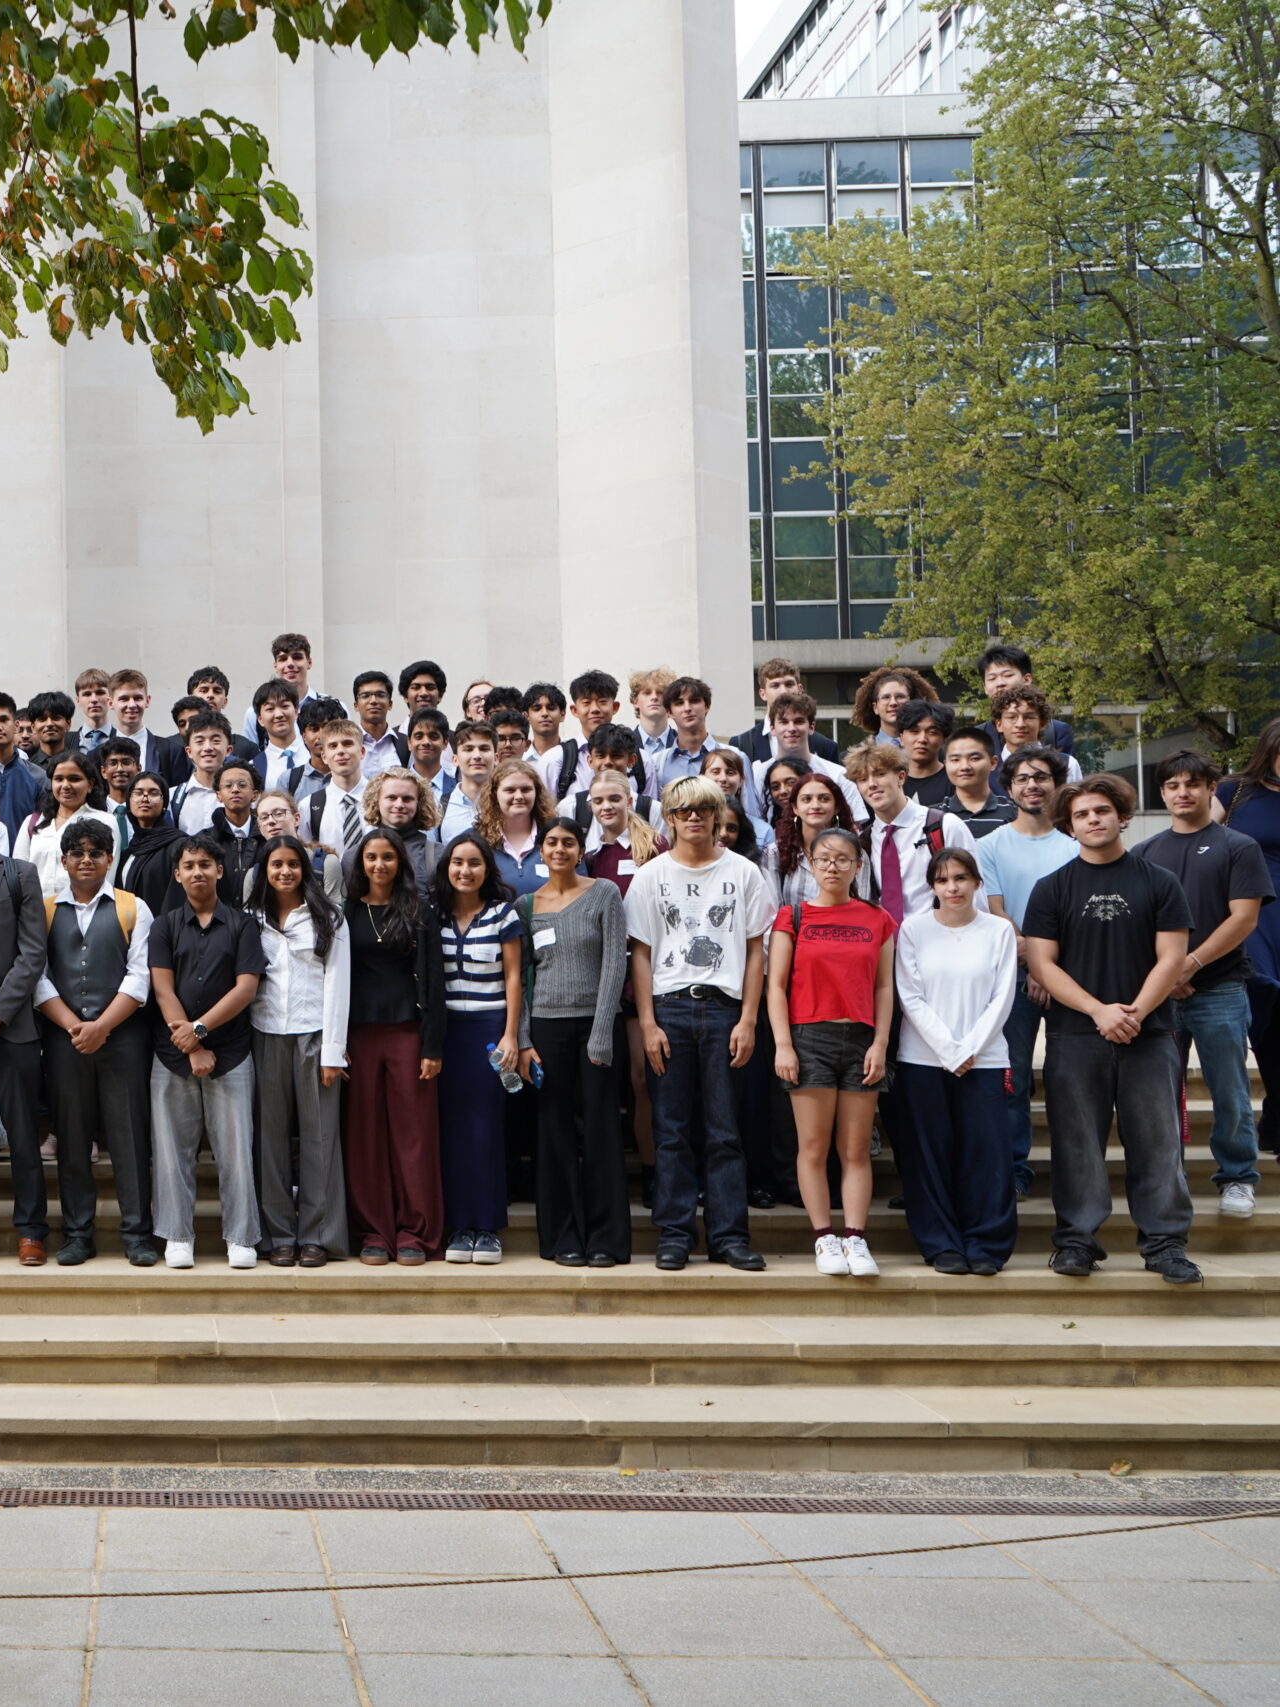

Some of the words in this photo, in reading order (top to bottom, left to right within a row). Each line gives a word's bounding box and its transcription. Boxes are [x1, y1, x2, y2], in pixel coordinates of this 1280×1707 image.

[659, 883, 671, 897] E
[686, 883, 701, 897] R
[722, 882, 736, 896] D
